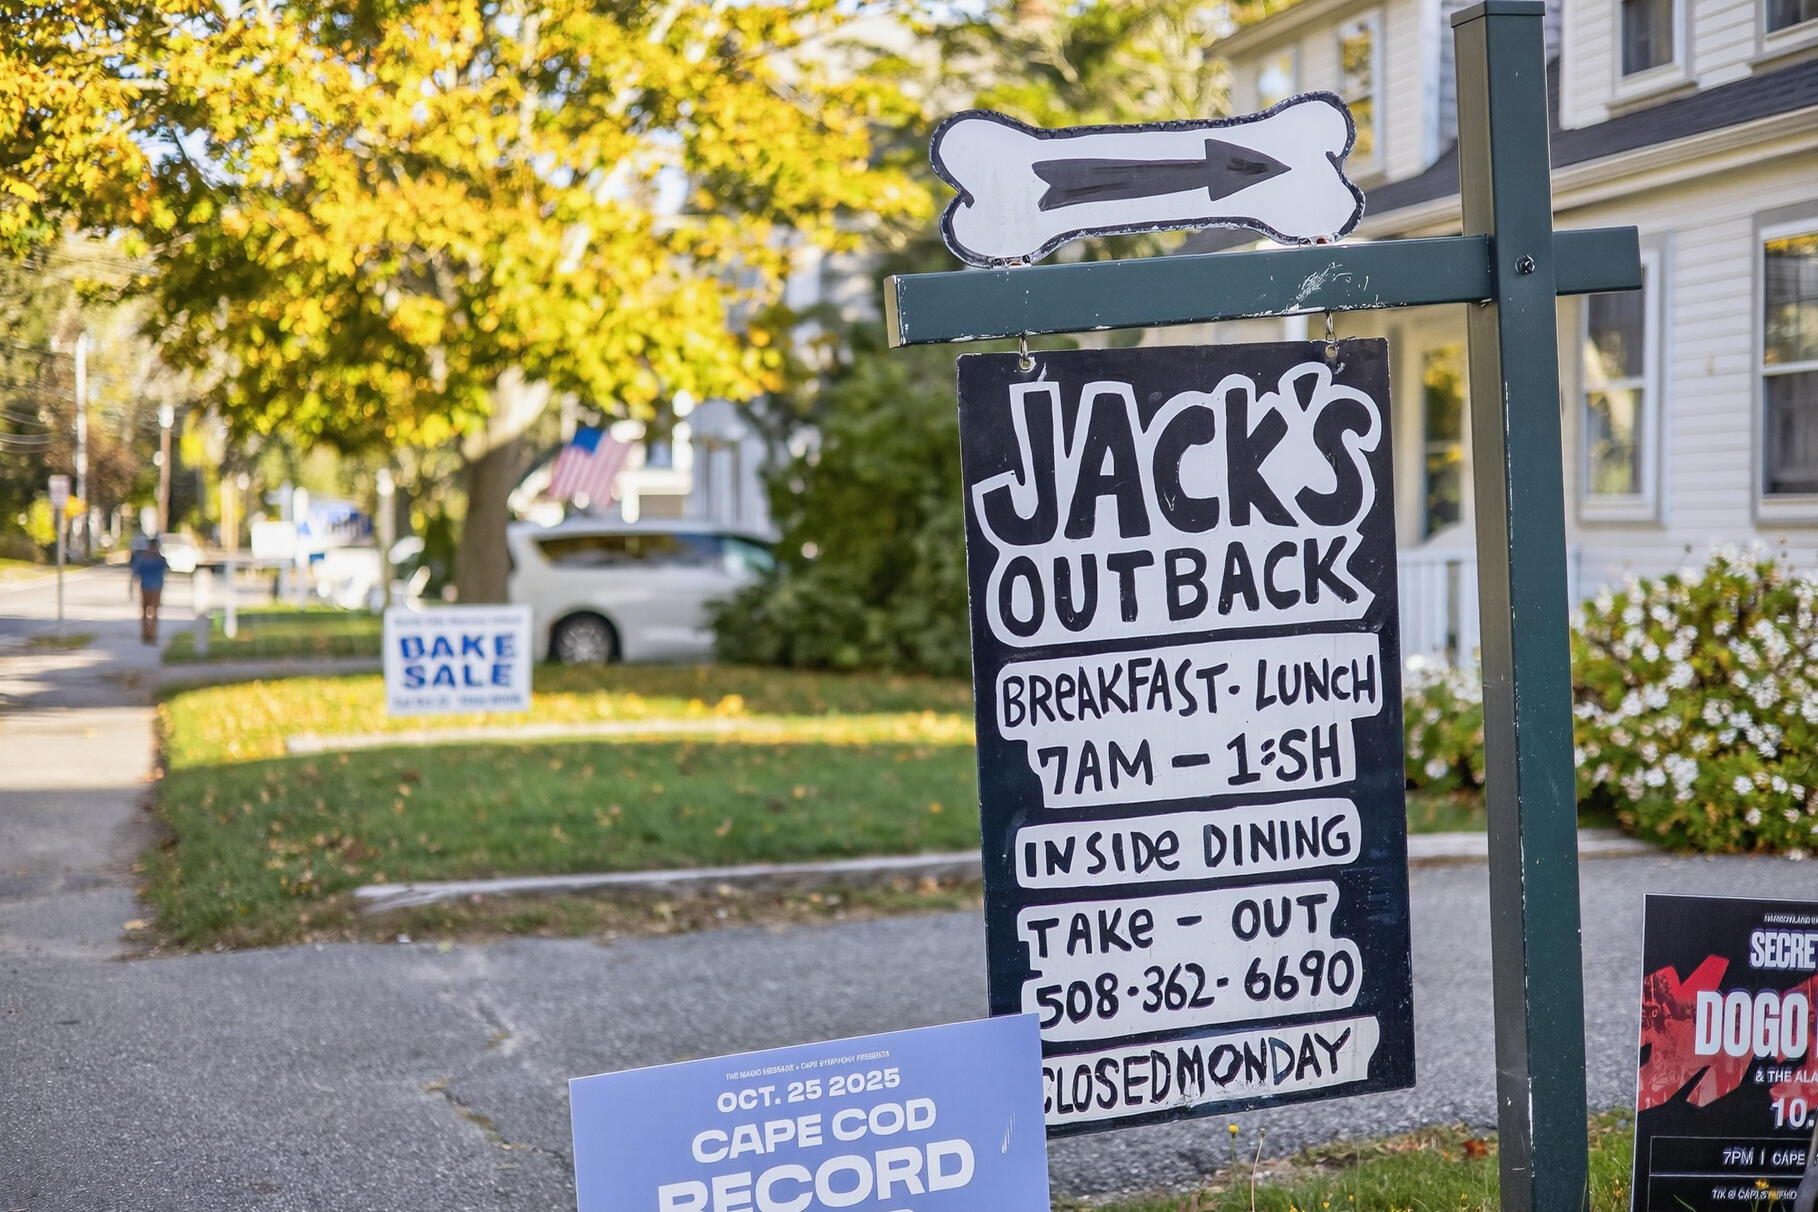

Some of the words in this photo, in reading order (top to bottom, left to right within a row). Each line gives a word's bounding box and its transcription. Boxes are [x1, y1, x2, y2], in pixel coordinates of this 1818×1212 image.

[983, 371, 1372, 546] JACK'S
[999, 535, 1358, 637] OUTBACK
[400, 633, 515, 660] BAKE
[404, 664, 512, 688] SALE
[1256, 654, 1376, 711] LUNCH
[1037, 738, 1154, 795] 7AM
[1203, 814, 1351, 868] DINING
[1231, 893, 1328, 942] OUT
[1750, 931, 1818, 968] SECRE
[1695, 991, 1808, 1059] DOGO
[717, 1085, 781, 1113] OCT.
[787, 1079, 823, 1103] 25
[829, 1067, 901, 1097] 2025
[1767, 1070, 1792, 1083] THE
[691, 1116, 823, 1163] CAPE
[831, 1097, 937, 1142] COD
[1771, 1097, 1815, 1128] 10.
[657, 1138, 975, 1212] RECORD
[1723, 1148, 1753, 1165] 7PM
[1772, 1151, 1806, 1166] CAPE
